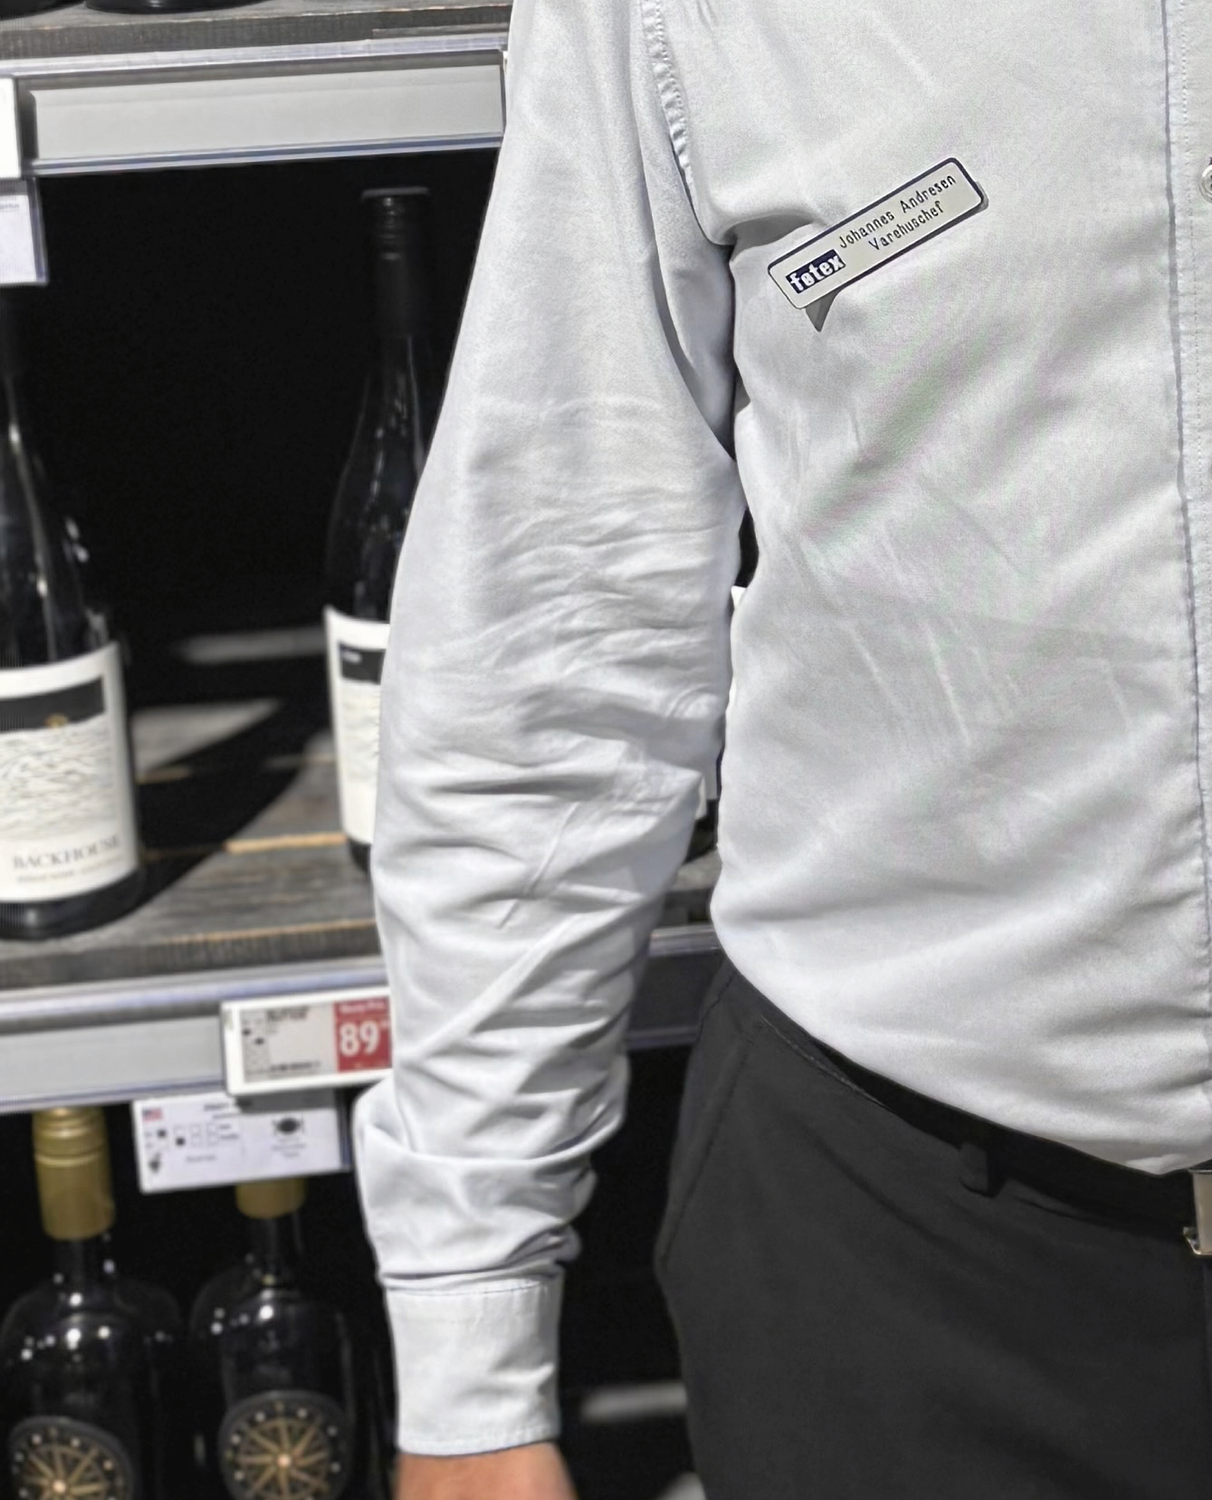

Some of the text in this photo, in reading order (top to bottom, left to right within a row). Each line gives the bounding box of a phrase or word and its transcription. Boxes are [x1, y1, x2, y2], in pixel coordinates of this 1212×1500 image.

[839, 174, 956, 249] Johannes Andresen
[868, 201, 944, 251] Varehuschef
[789, 253, 845, 292] føtex
[13, 834, 121, 869] BACKHOUSE
[339, 1020, 380, 1056] 89
